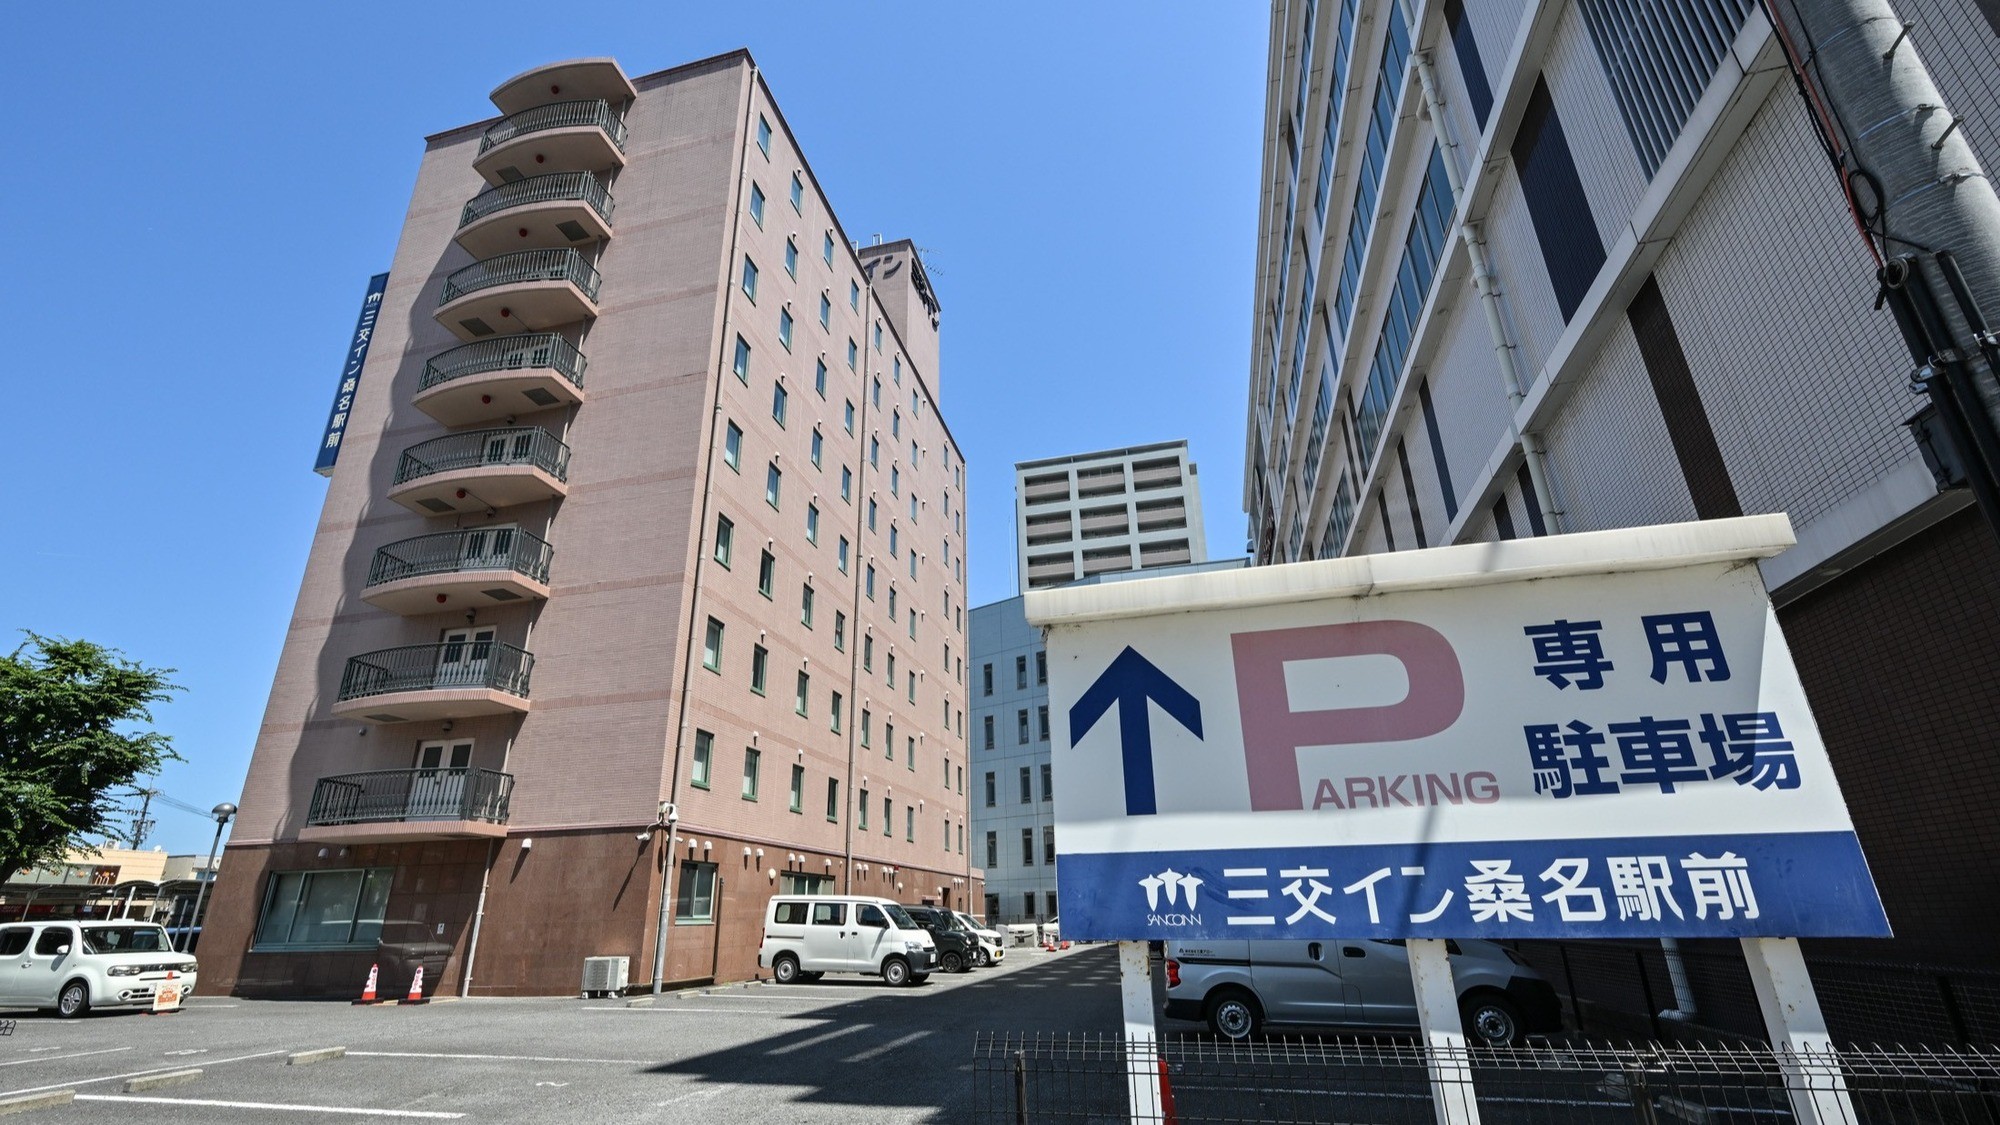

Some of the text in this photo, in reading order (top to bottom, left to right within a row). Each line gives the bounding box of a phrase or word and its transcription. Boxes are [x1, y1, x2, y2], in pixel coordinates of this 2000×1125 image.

[326, 310, 376, 448] 三交イン桑名駅前
[1523, 711, 1801, 799] 駐車場
[1223, 851, 1760, 925] 三交イン桑名駅前
